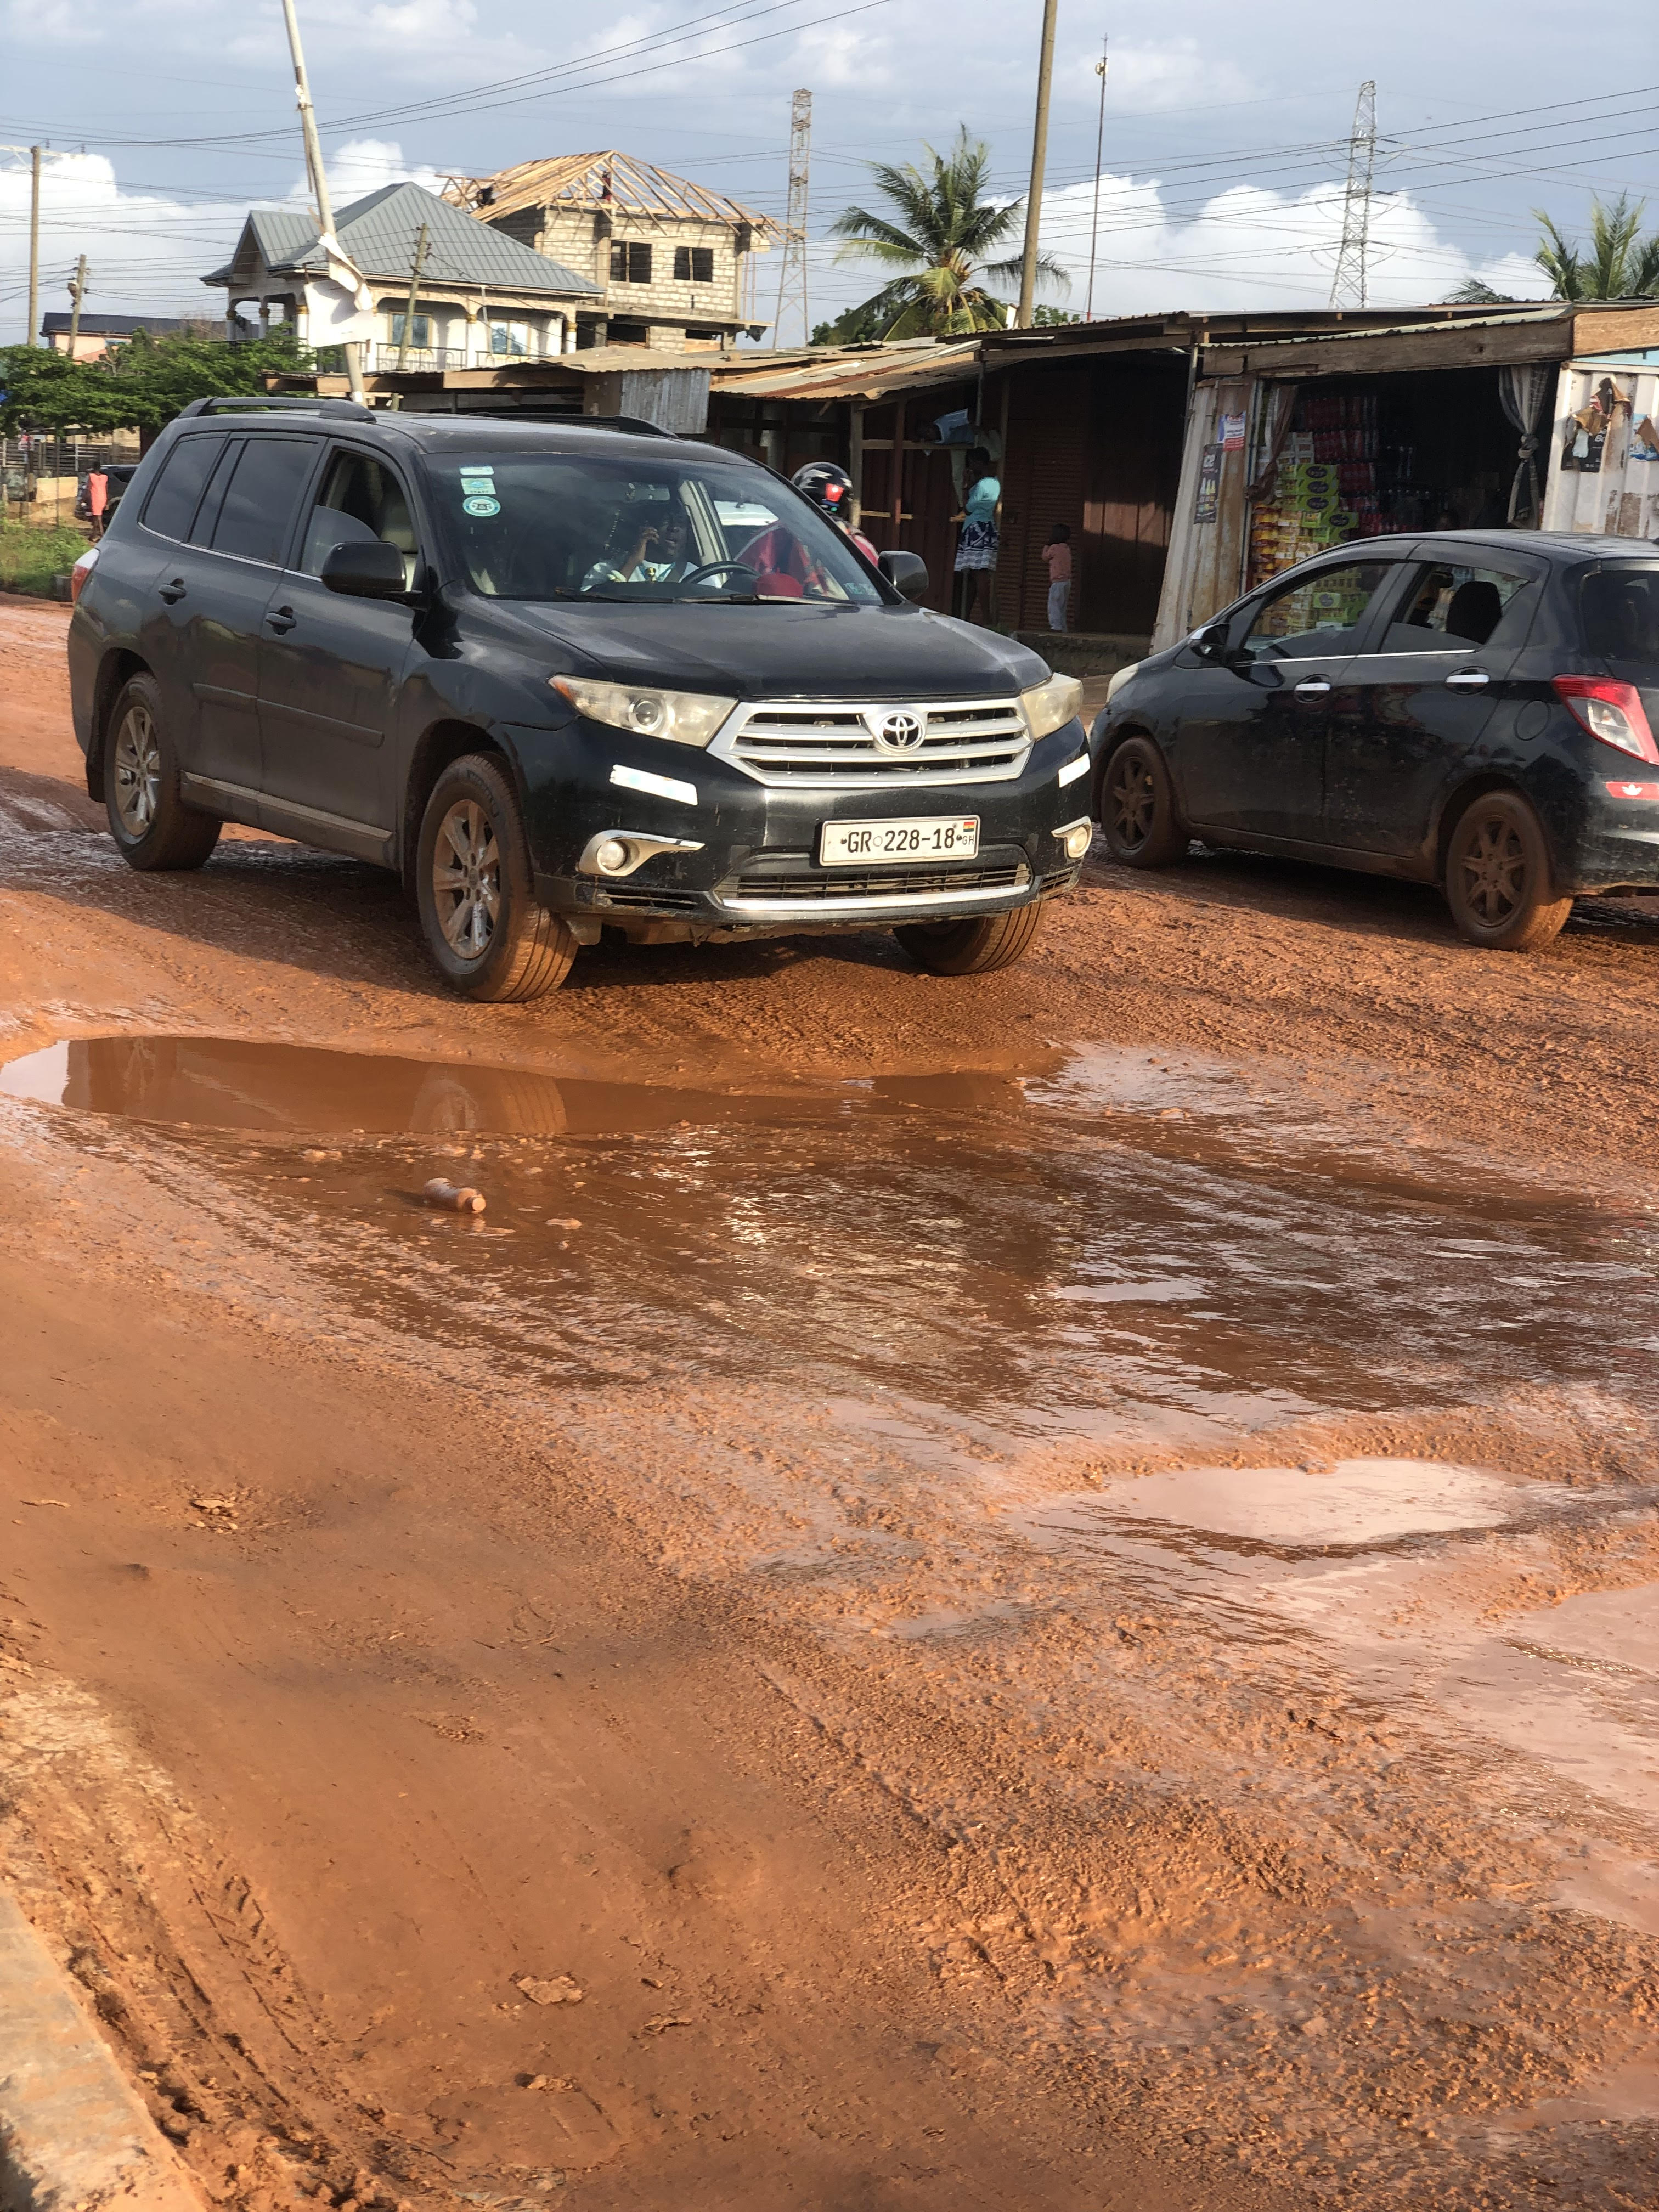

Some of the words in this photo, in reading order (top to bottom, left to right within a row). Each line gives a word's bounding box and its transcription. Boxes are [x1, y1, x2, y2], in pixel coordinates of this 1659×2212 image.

[847, 831, 872, 853] GR
[884, 827, 955, 851] 228-18
[962, 834, 975, 845] GH
